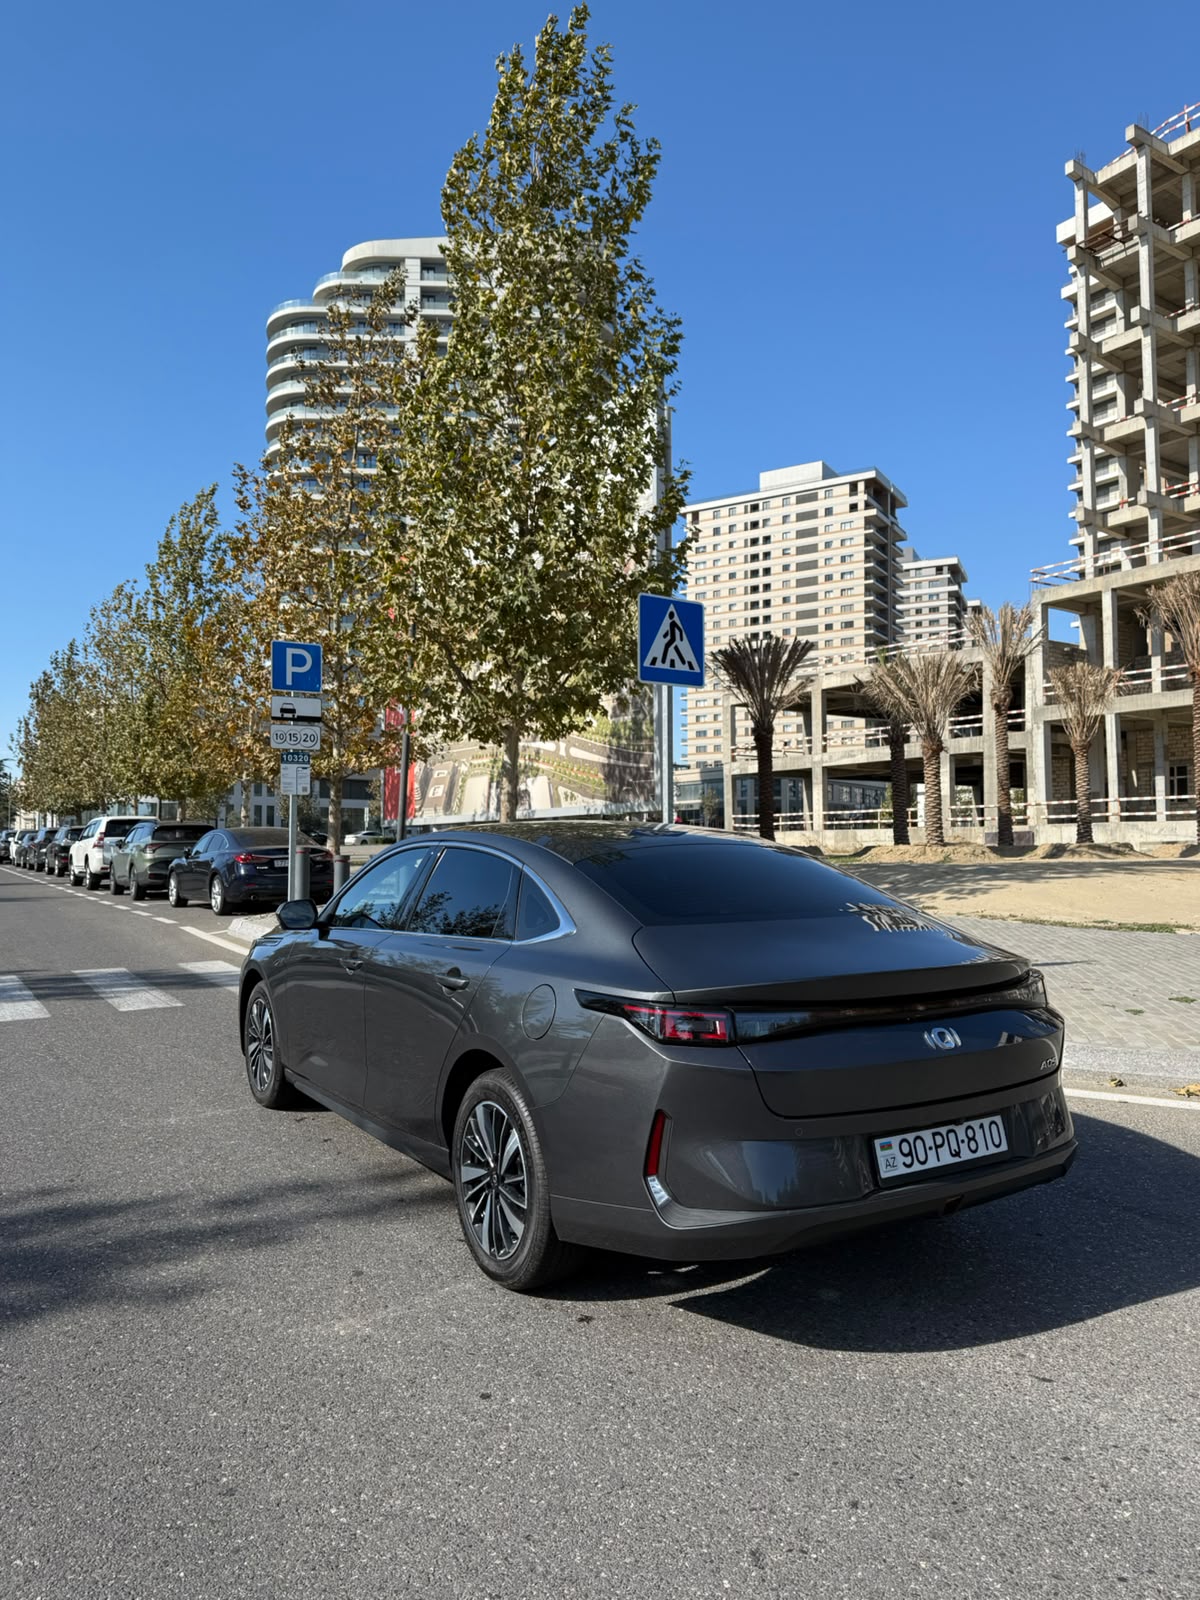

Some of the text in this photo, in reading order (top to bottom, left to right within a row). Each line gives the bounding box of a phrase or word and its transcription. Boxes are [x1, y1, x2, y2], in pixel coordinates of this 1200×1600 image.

[286, 647, 313, 686] P
[275, 733, 315, 744] 10 15 20
[282, 754, 309, 762] 10320
[885, 1157, 898, 1170] AZ
